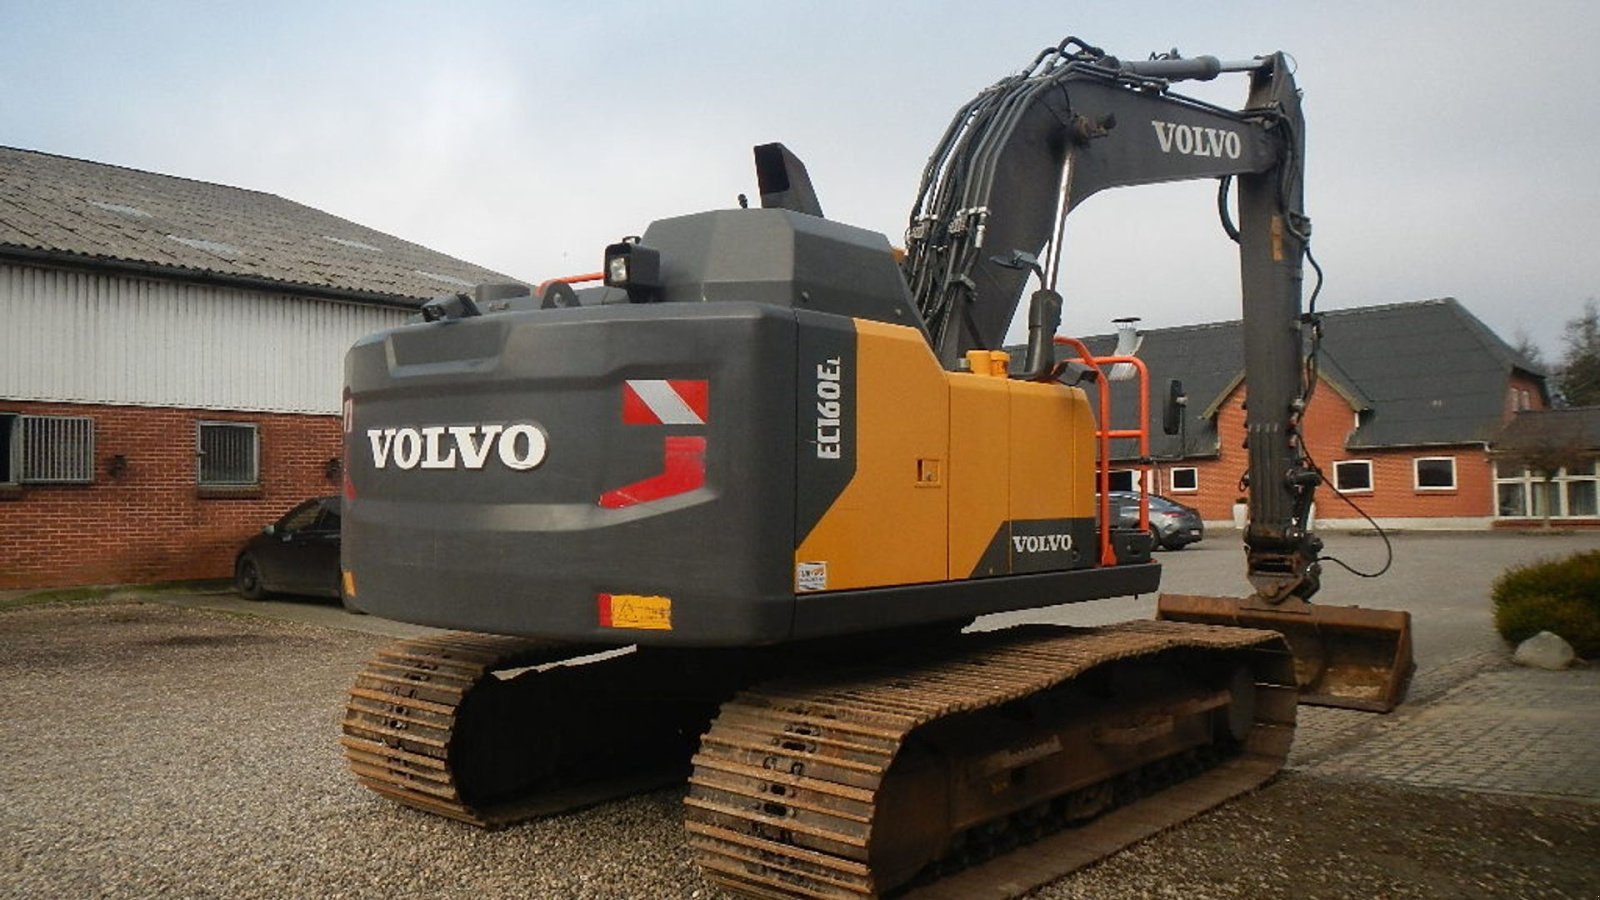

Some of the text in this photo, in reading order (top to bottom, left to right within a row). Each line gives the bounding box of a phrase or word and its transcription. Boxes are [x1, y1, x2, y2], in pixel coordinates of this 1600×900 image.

[1151, 120, 1242, 159] VOLVO
[366, 424, 547, 471] VOLVO
[1012, 534, 1073, 553] VOLVO
